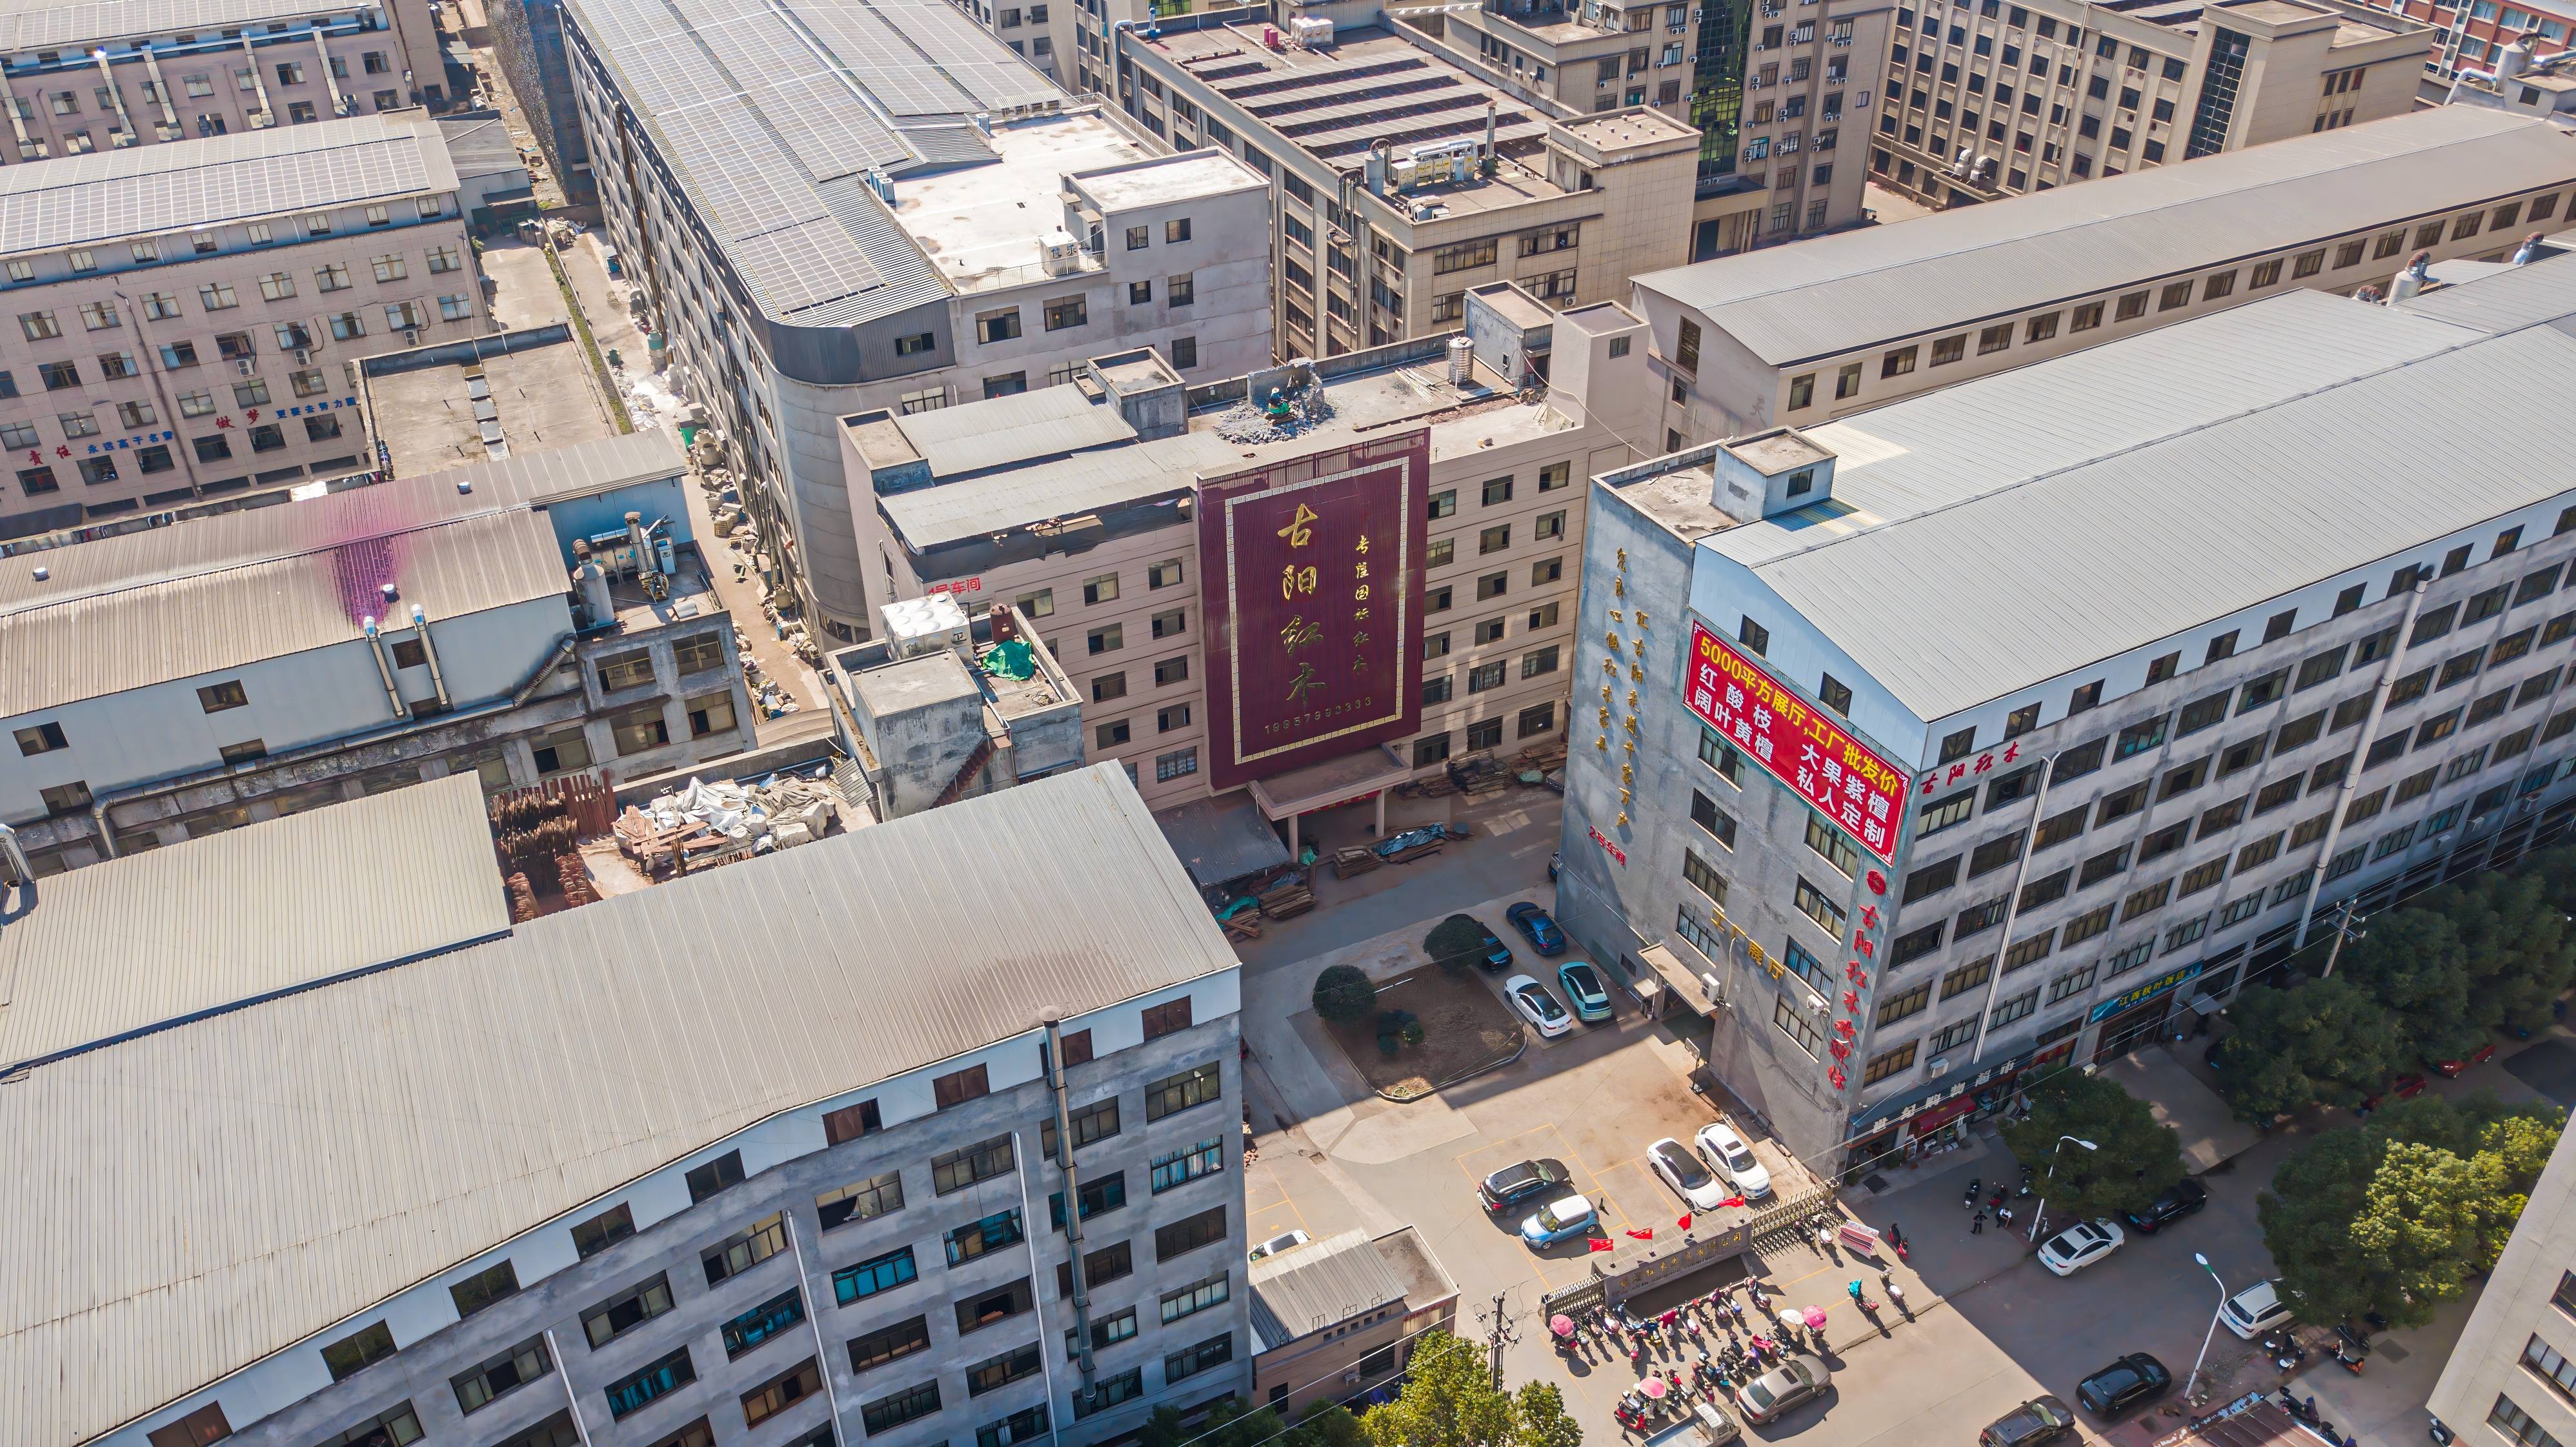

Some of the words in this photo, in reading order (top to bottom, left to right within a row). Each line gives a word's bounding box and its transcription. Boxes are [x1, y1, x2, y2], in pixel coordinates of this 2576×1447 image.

[28, 445, 72, 466] 责任
[1277, 503, 1329, 708] 古阳红木
[1694, 685, 1774, 764] 阔叶黄檀
[1796, 766, 1886, 849] 私人定制
[1699, 663, 1773, 734] 红酸枝
[1800, 743, 1890, 824] 大果紫檀
[1920, 740, 2020, 795] 古阳红木
[1589, 825, 1626, 866] 2号车间
[1711, 907, 1786, 980] 工厂展厅
